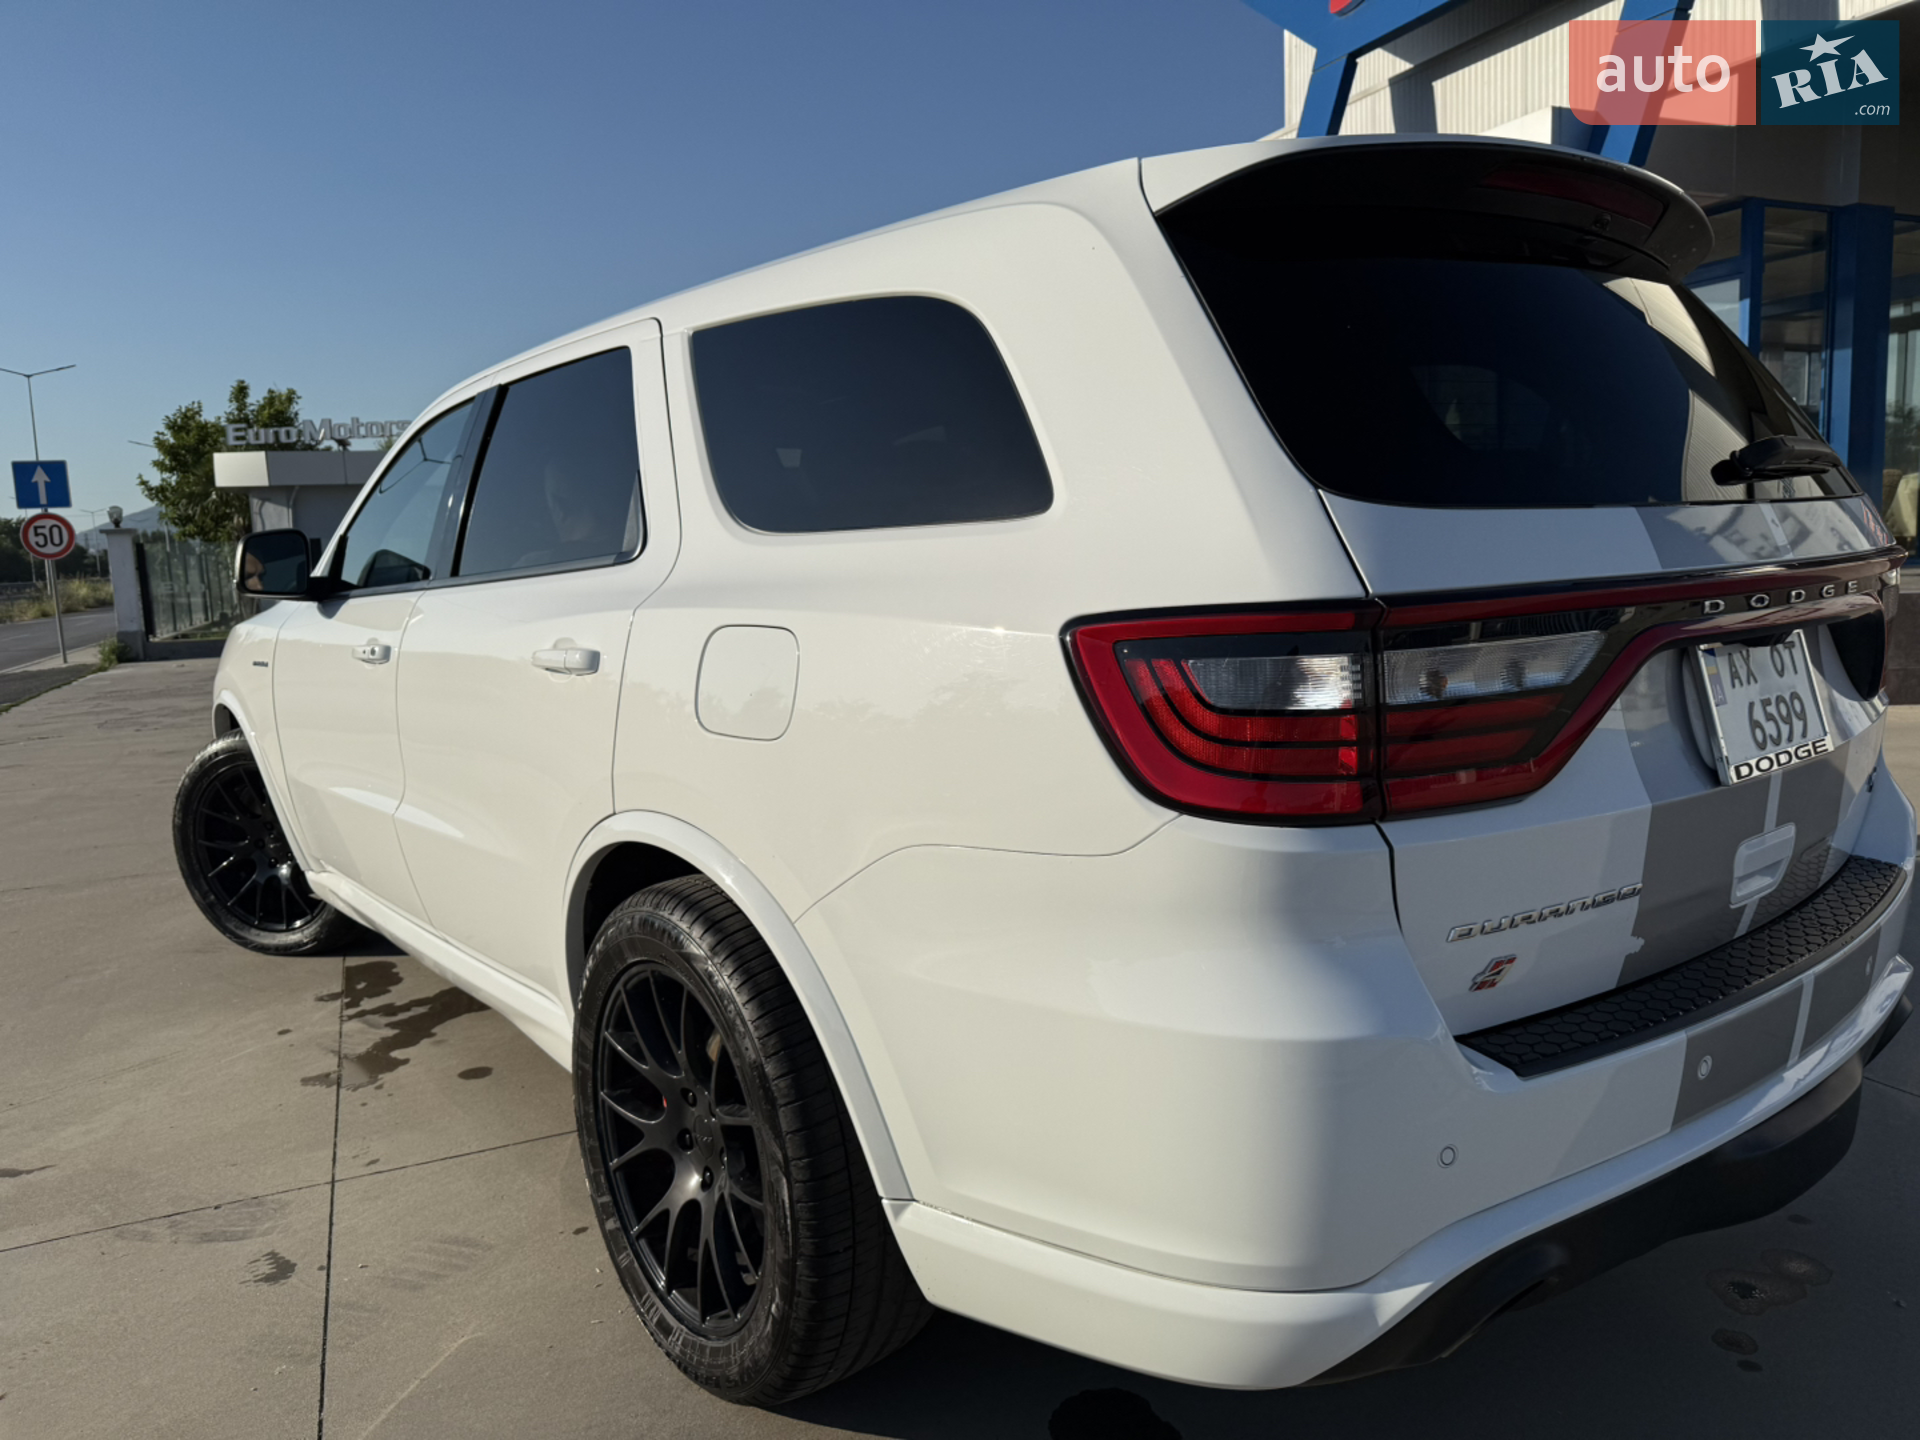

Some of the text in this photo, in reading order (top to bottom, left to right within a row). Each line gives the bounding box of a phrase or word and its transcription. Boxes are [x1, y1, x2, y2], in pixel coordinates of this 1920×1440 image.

[225, 417, 413, 446] Euro Motors
[32, 524, 64, 549] 50
[1703, 580, 1858, 614] DODGE
[1728, 648, 1758, 689] AX
[1748, 691, 1808, 751] 6599
[1733, 738, 1829, 781] DODGE
[1446, 882, 1644, 943] DURANGO
